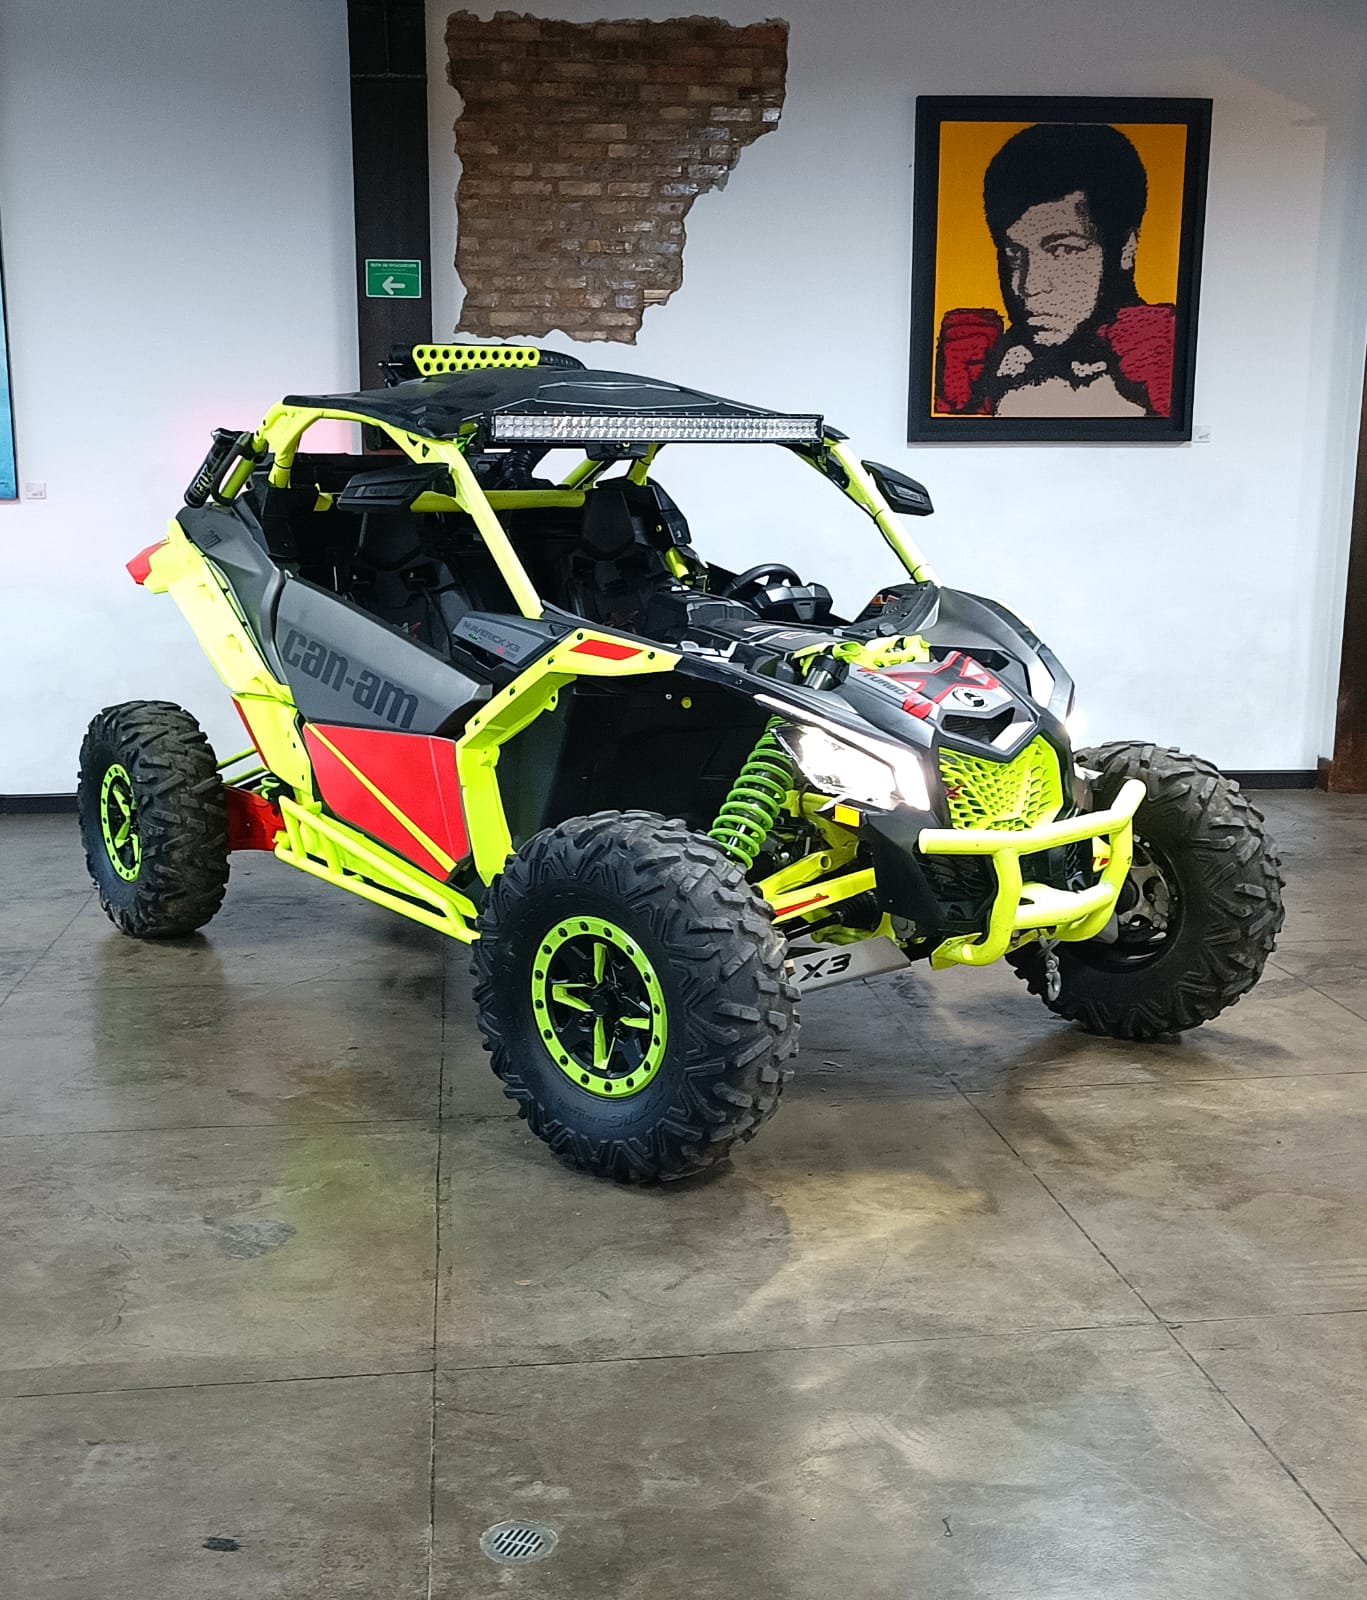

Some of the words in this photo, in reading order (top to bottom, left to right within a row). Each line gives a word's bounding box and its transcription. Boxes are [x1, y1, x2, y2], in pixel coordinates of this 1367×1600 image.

[281, 629, 419, 729] can-am
[863, 672, 908, 696] TURBO
[799, 953, 852, 984] X3
